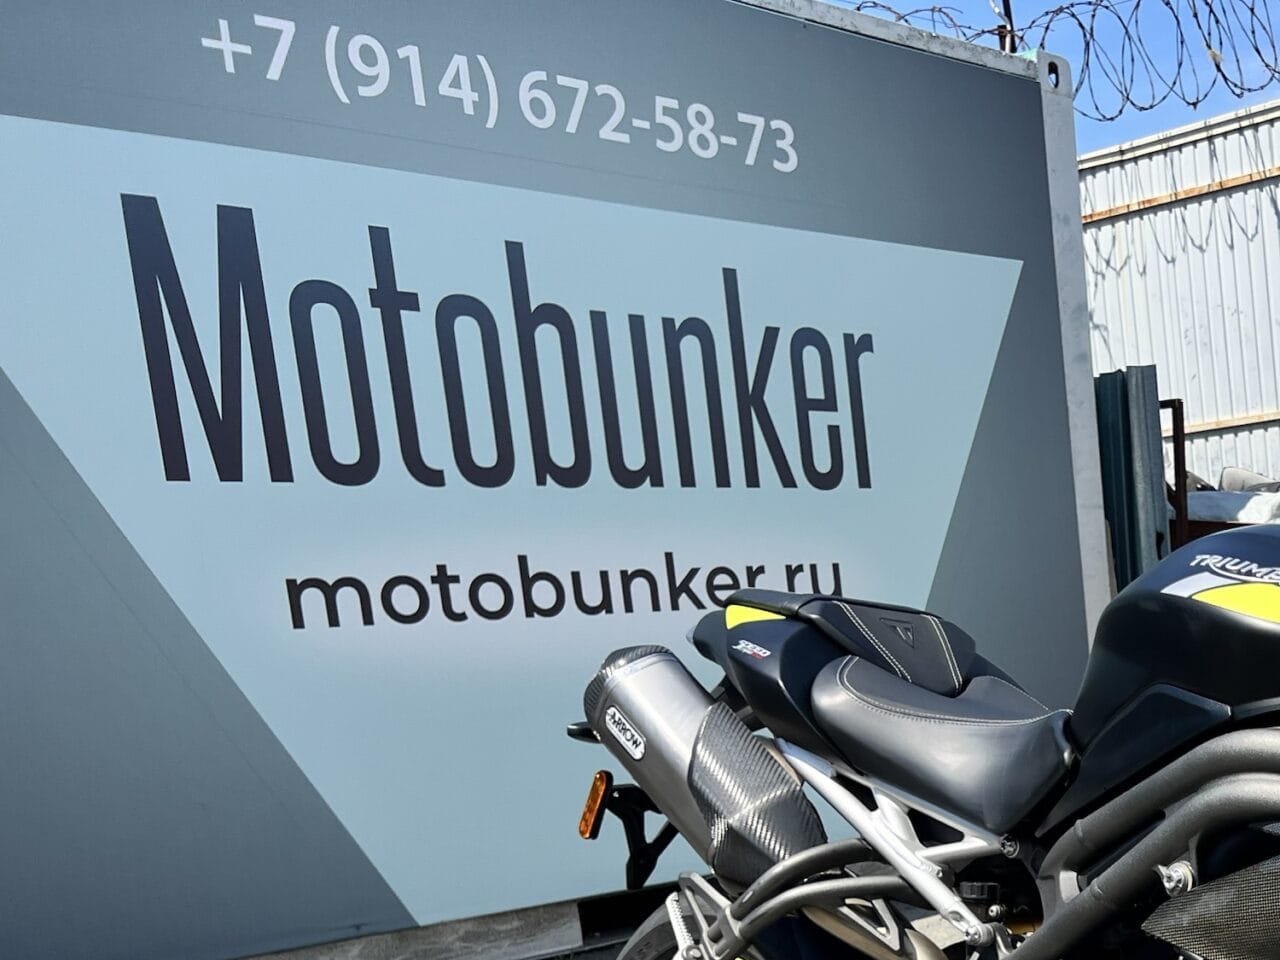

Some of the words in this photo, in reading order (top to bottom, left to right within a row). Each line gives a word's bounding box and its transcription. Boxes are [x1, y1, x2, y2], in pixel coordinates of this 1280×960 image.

[201, 14, 296, 82] +7
[325, 26, 499, 128] (914)
[519, 70, 799, 172] 672-58-73
[120, 193, 873, 490] Motobunker
[285, 552, 843, 630] motobunkerru
[605, 707, 643, 751] ARROW
